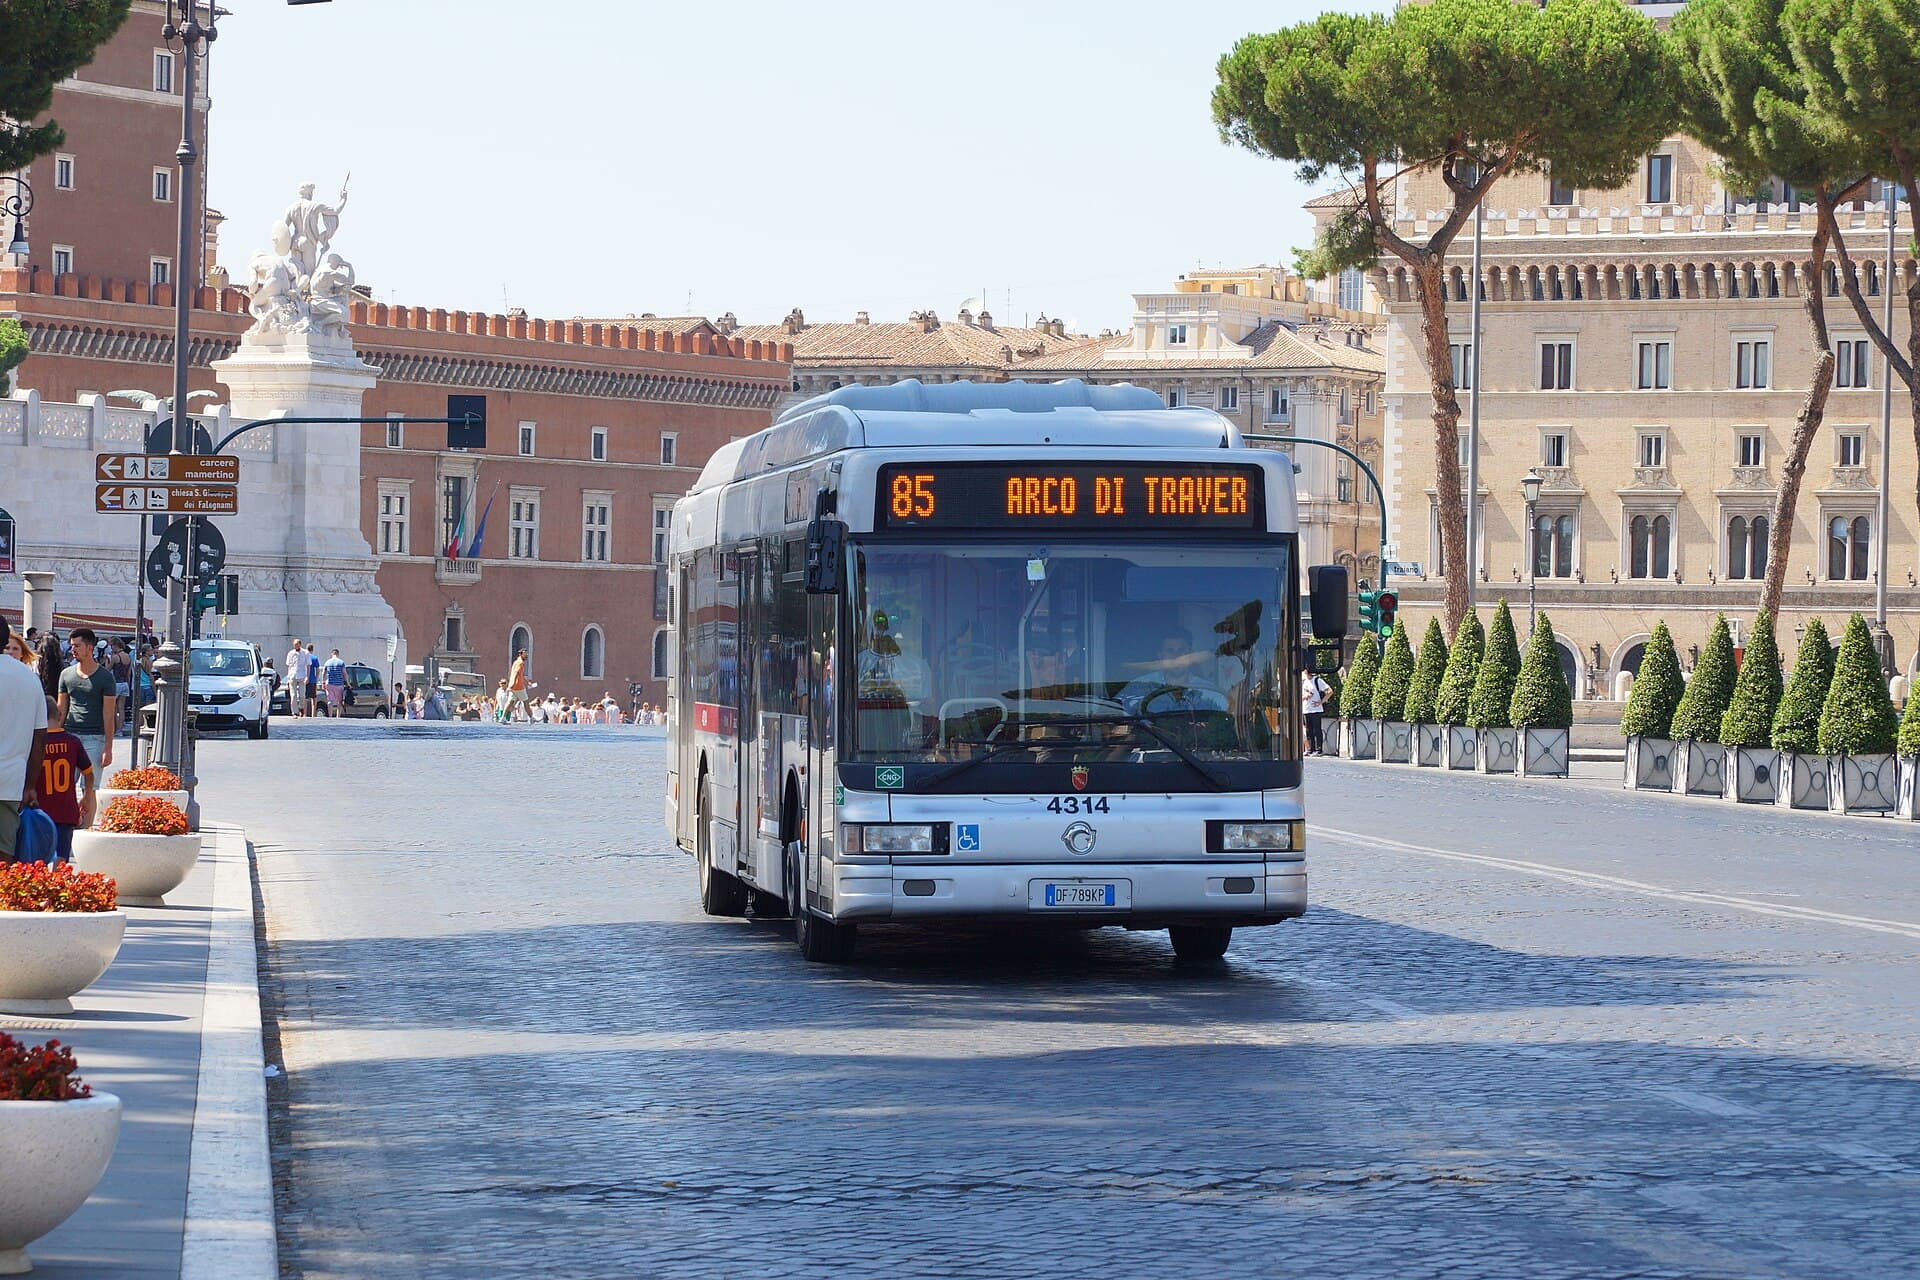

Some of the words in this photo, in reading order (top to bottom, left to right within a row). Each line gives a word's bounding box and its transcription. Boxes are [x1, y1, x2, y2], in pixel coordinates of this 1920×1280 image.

[200, 459, 234, 467] carcere
[185, 470, 234, 479] mamertino
[171, 488, 193, 497] chiesa
[194, 488, 202, 497] S.
[892, 475, 934, 517] 85
[1007, 477, 1076, 514] ARCO
[1095, 477, 1124, 514] DI
[1144, 477, 1247, 514] TRAVER
[184, 500, 195, 508] dei
[198, 500, 233, 510] Falegnami
[42, 758, 70, 795] 10
[1047, 796, 1110, 814] 4314
